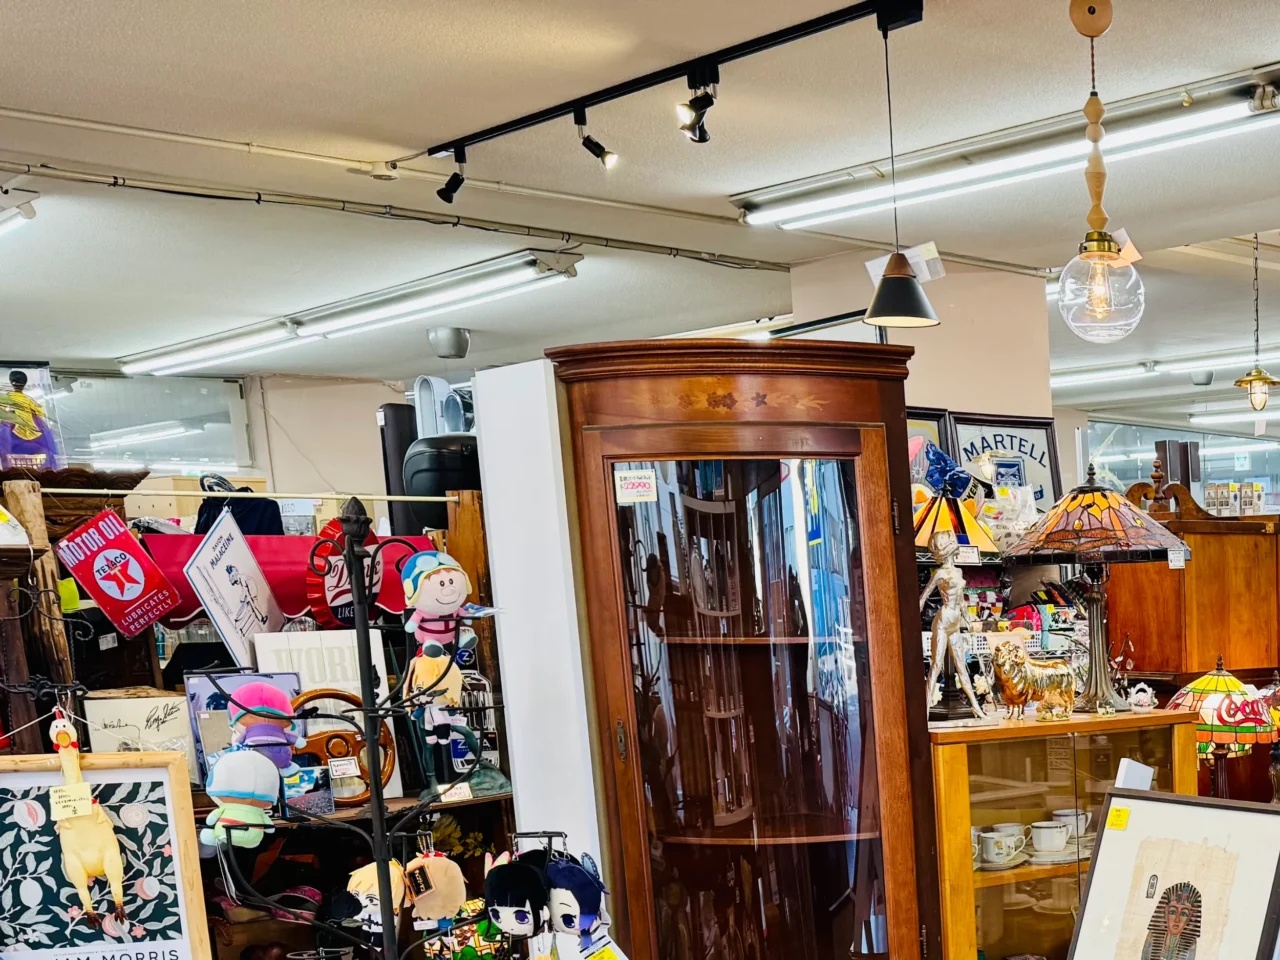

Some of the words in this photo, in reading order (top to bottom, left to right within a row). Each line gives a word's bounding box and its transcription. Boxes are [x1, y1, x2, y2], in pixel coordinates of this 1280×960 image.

[963, 433, 1047, 468] MARTELL
[58, 527, 101, 567] MOTOR
[99, 514, 126, 541] OIL
[95, 552, 127, 577] TEXACO
[121, 589, 169, 626] LUBRICATES
[130, 598, 173, 632] PERFECTLY
